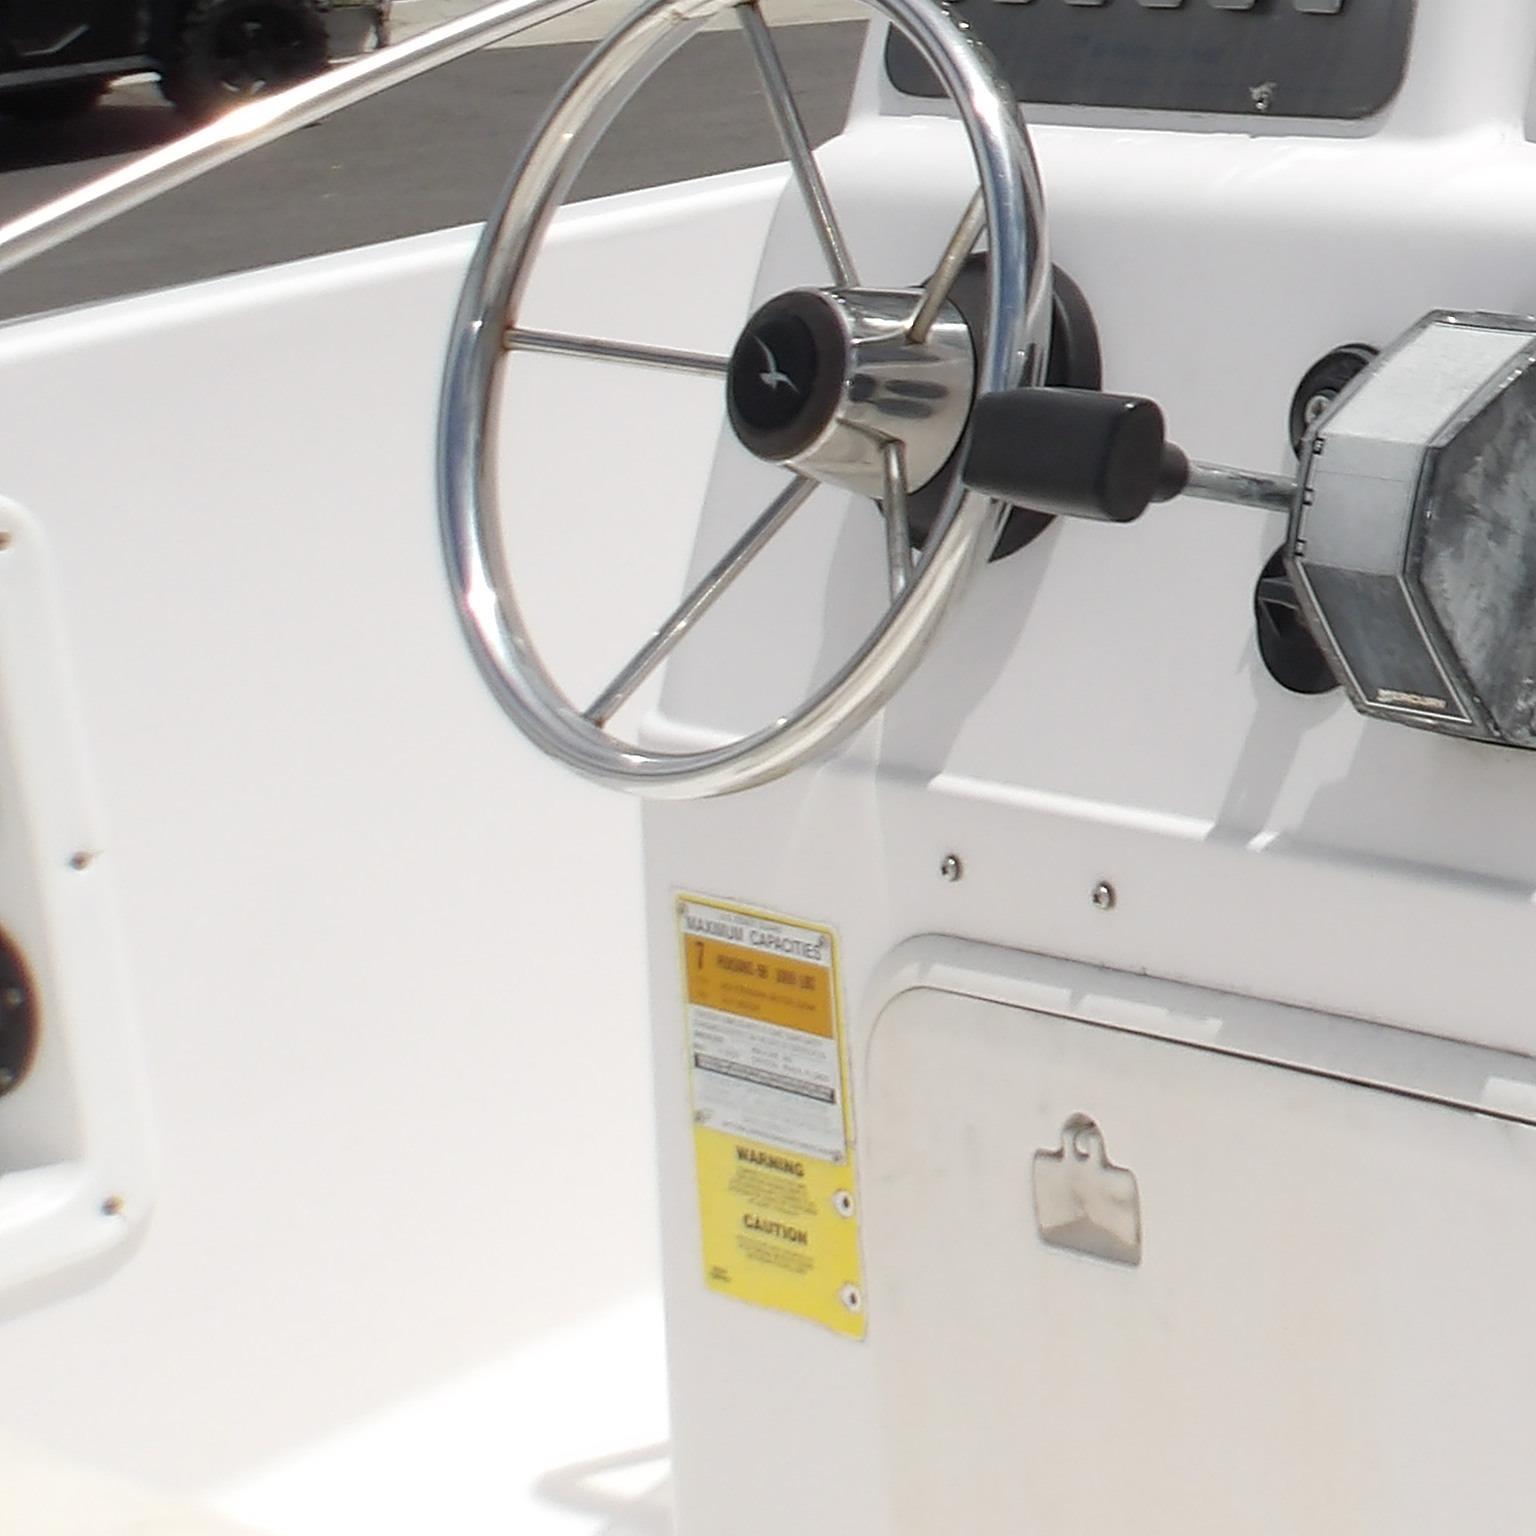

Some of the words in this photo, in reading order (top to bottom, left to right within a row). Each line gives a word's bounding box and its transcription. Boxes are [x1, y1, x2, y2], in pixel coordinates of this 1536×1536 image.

[686, 916, 744, 942] MAXIMUM
[750, 929, 822, 961] CAPACITIES
[736, 1145, 805, 1178] WARNING
[742, 1213, 808, 1246] CAUTION
